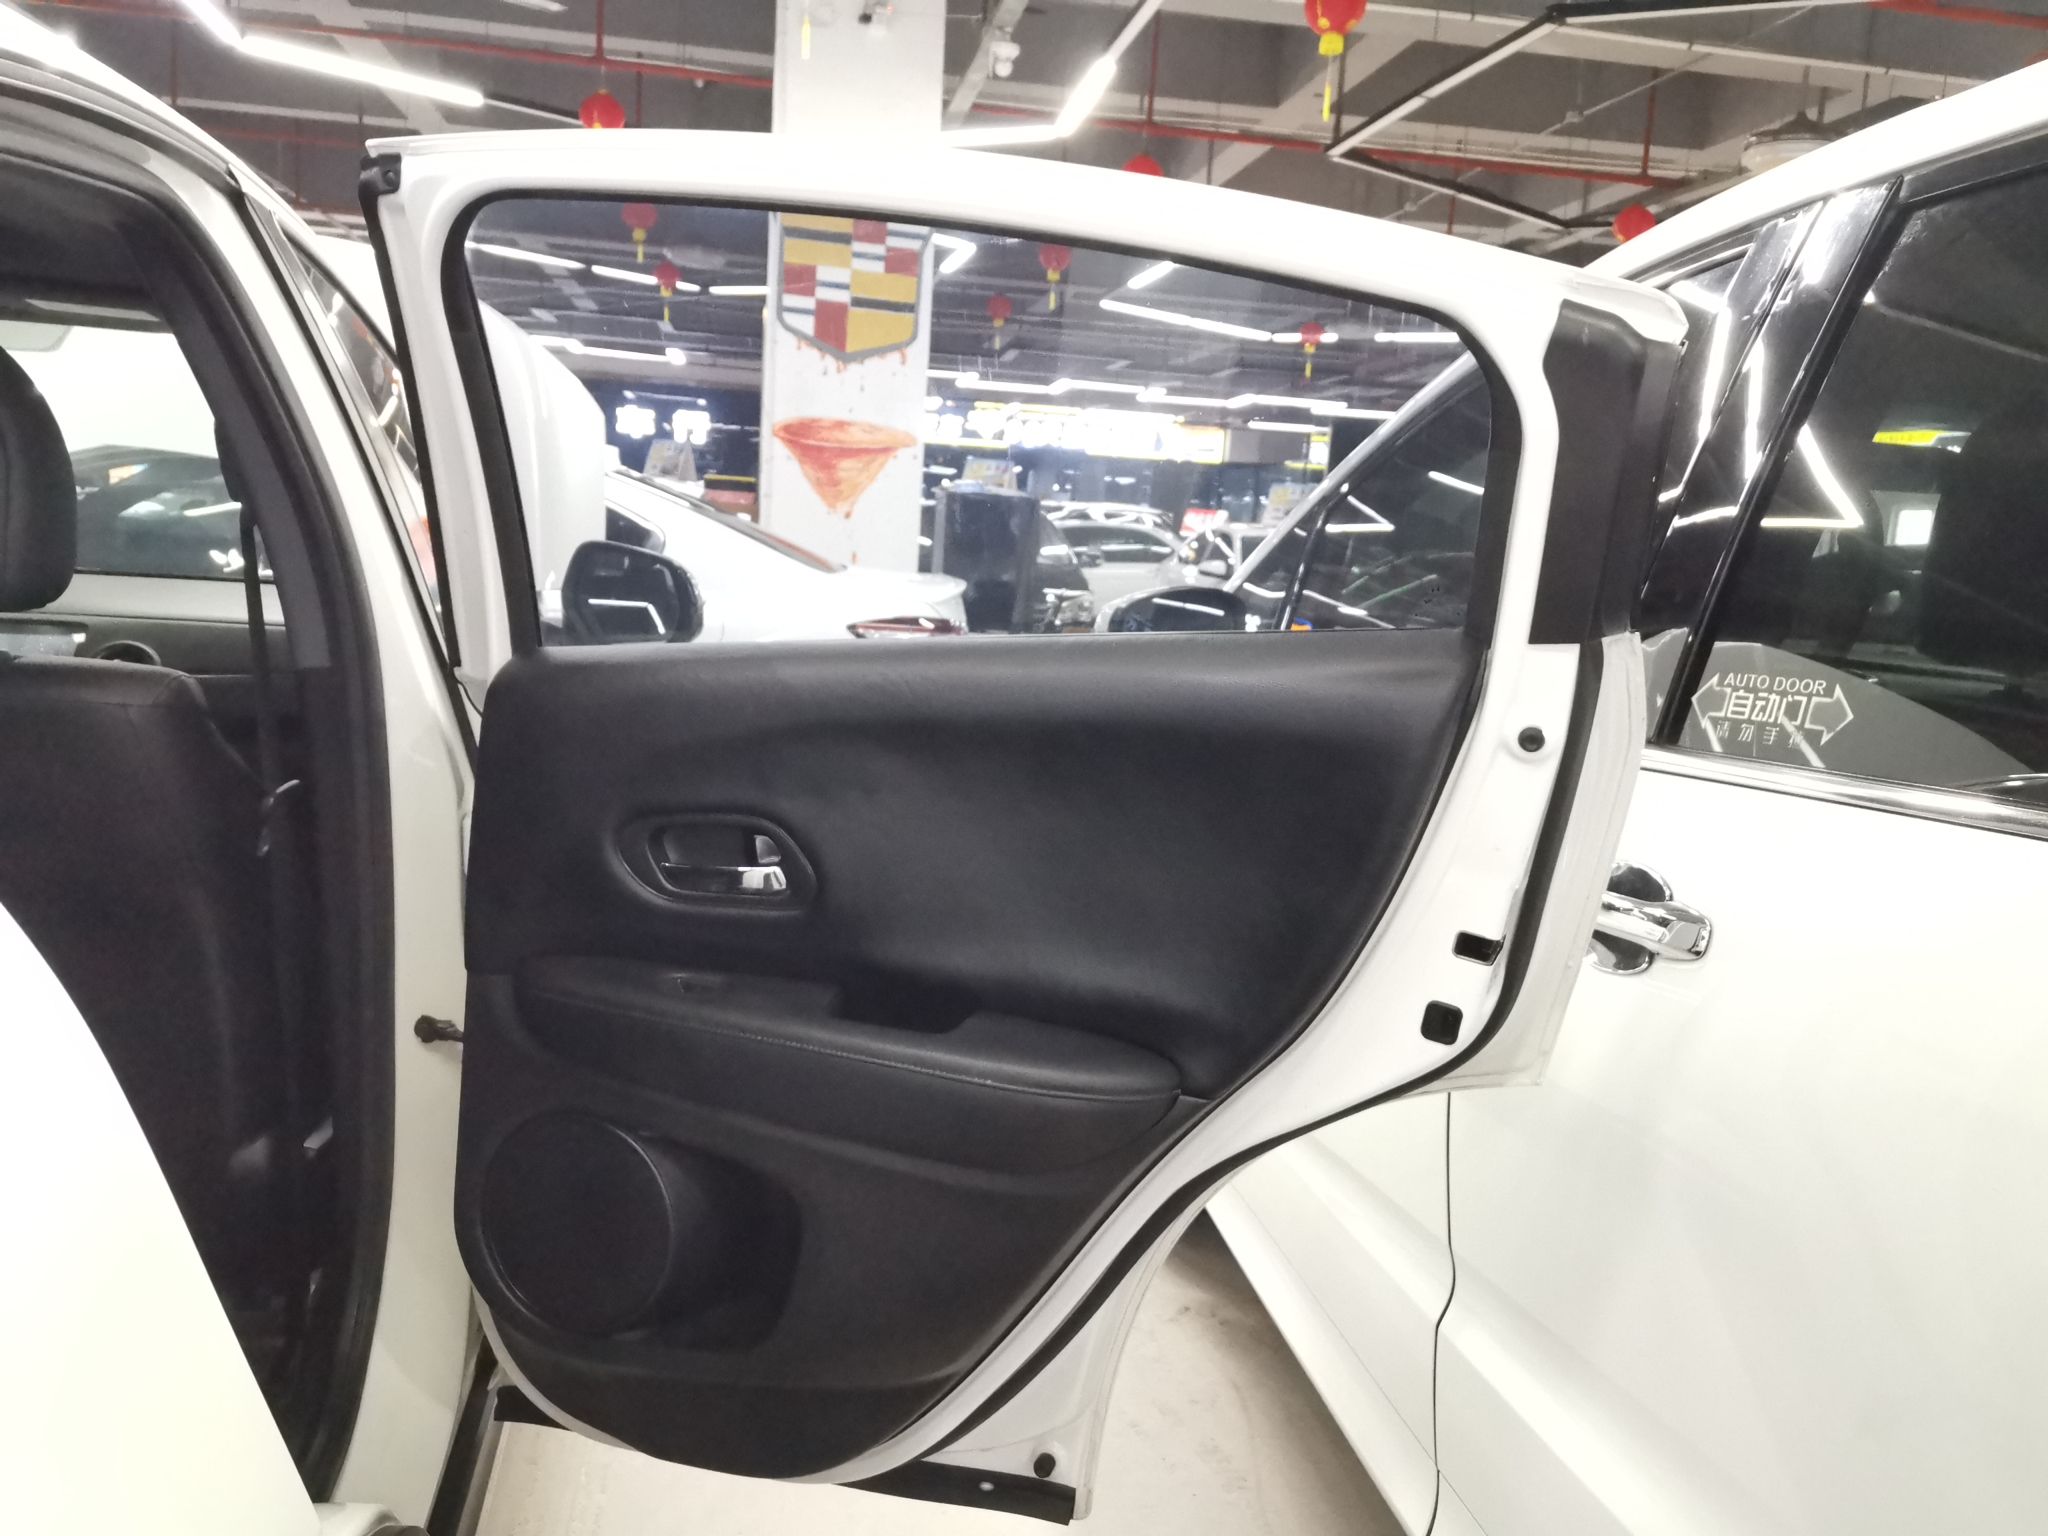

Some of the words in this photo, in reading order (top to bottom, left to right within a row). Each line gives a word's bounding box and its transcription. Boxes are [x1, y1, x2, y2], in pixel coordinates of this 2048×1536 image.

[1723, 672, 1770, 689] AUTO
[1773, 676, 1827, 695] DOOR
[1726, 689, 1808, 726] 自动门
